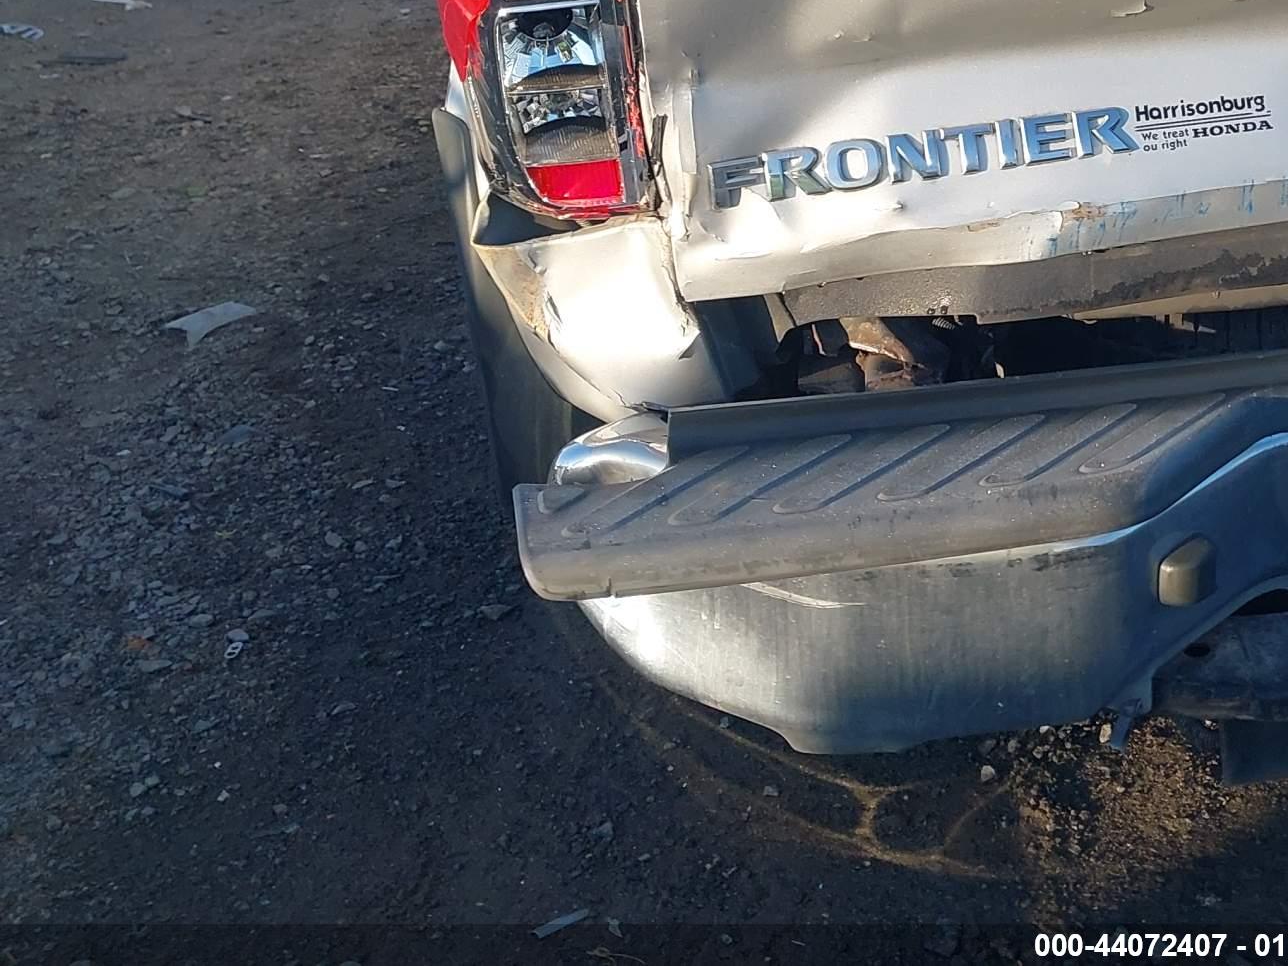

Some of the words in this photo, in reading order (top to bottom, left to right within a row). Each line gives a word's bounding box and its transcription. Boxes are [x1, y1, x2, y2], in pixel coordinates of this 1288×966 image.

[1135, 95, 1266, 122] Harrisonburg
[1141, 132, 1159, 141] We
[1163, 128, 1190, 139] treat
[1192, 120, 1274, 138] HONDA
[1161, 139, 1188, 151] right
[708, 106, 1142, 211] FRONTIER
